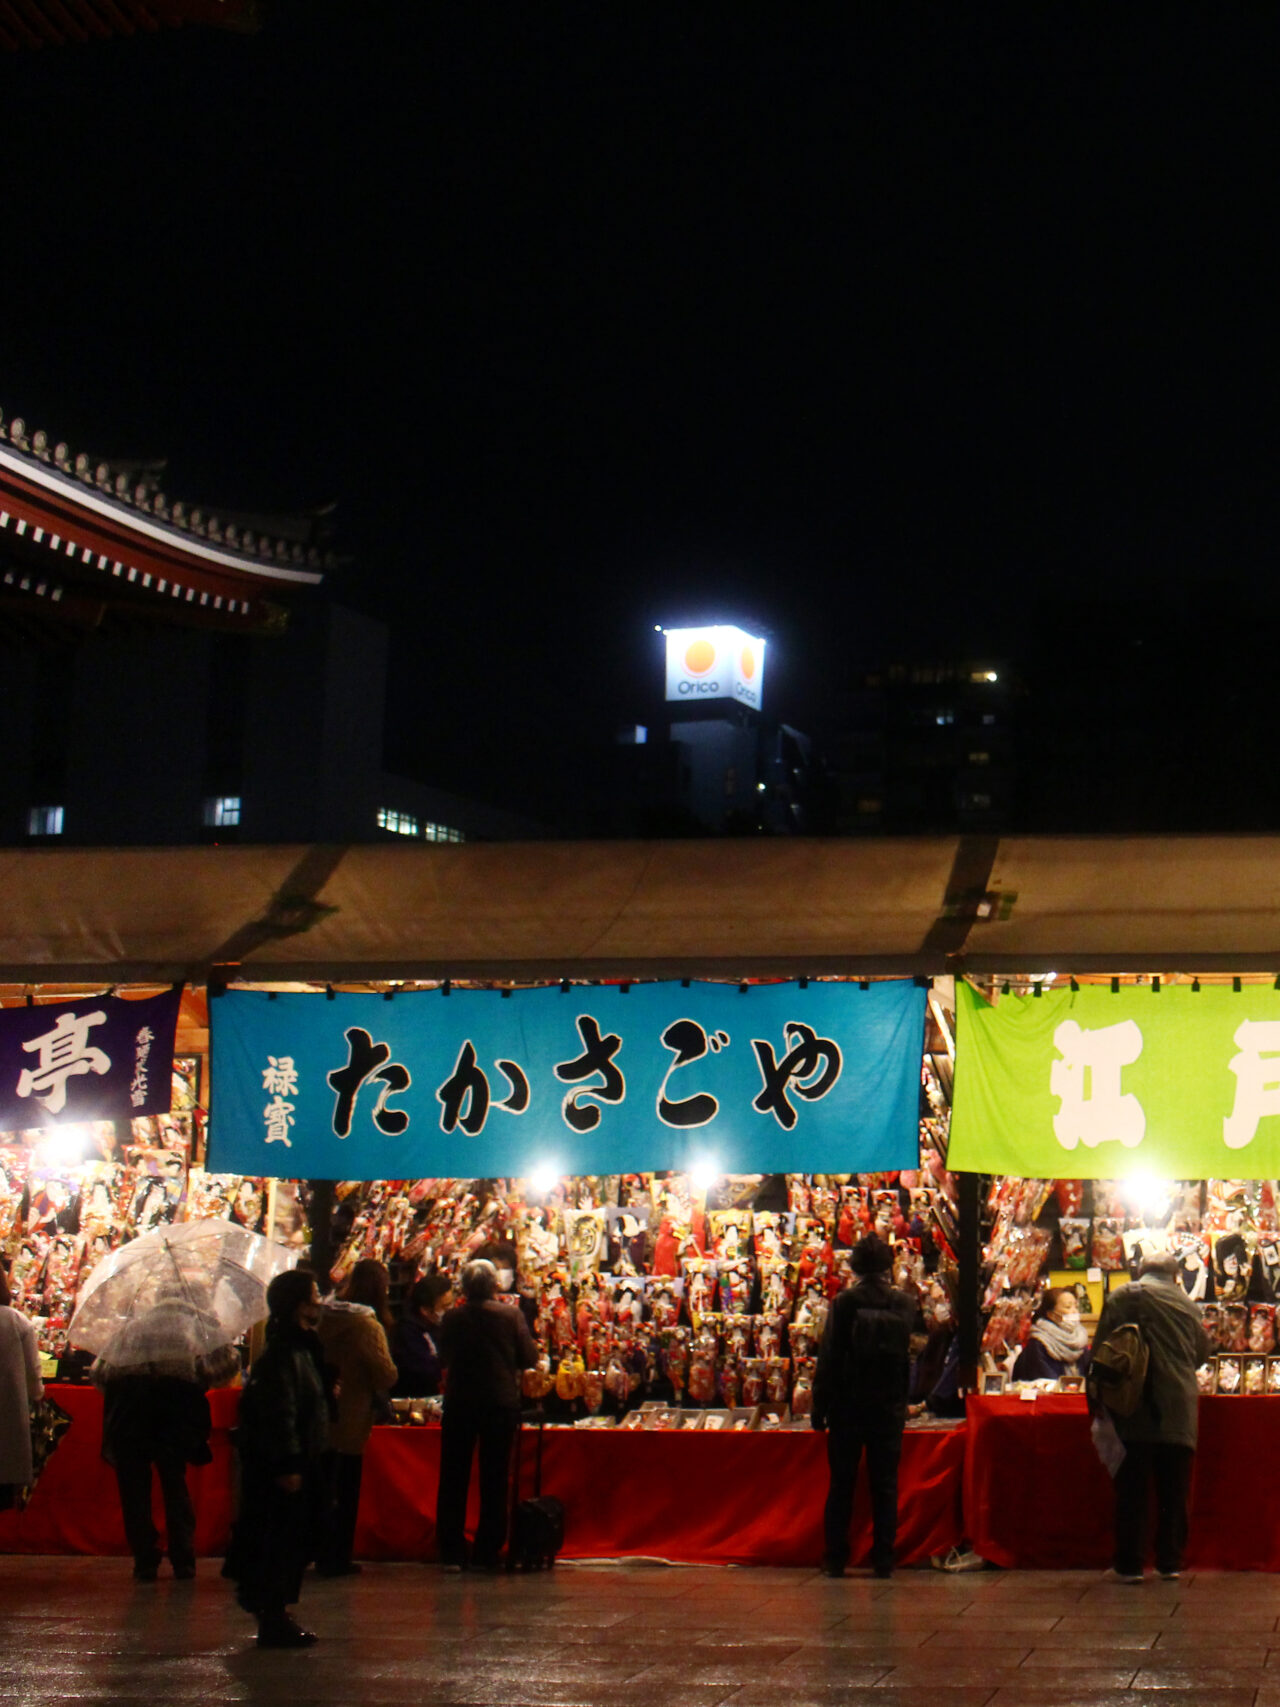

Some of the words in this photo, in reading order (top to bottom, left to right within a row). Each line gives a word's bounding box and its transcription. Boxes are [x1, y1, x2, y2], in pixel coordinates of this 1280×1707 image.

[678, 681, 719, 694] Orico
[16, 1010, 111, 1114] 亭
[327, 1014, 843, 1139] たかさごや
